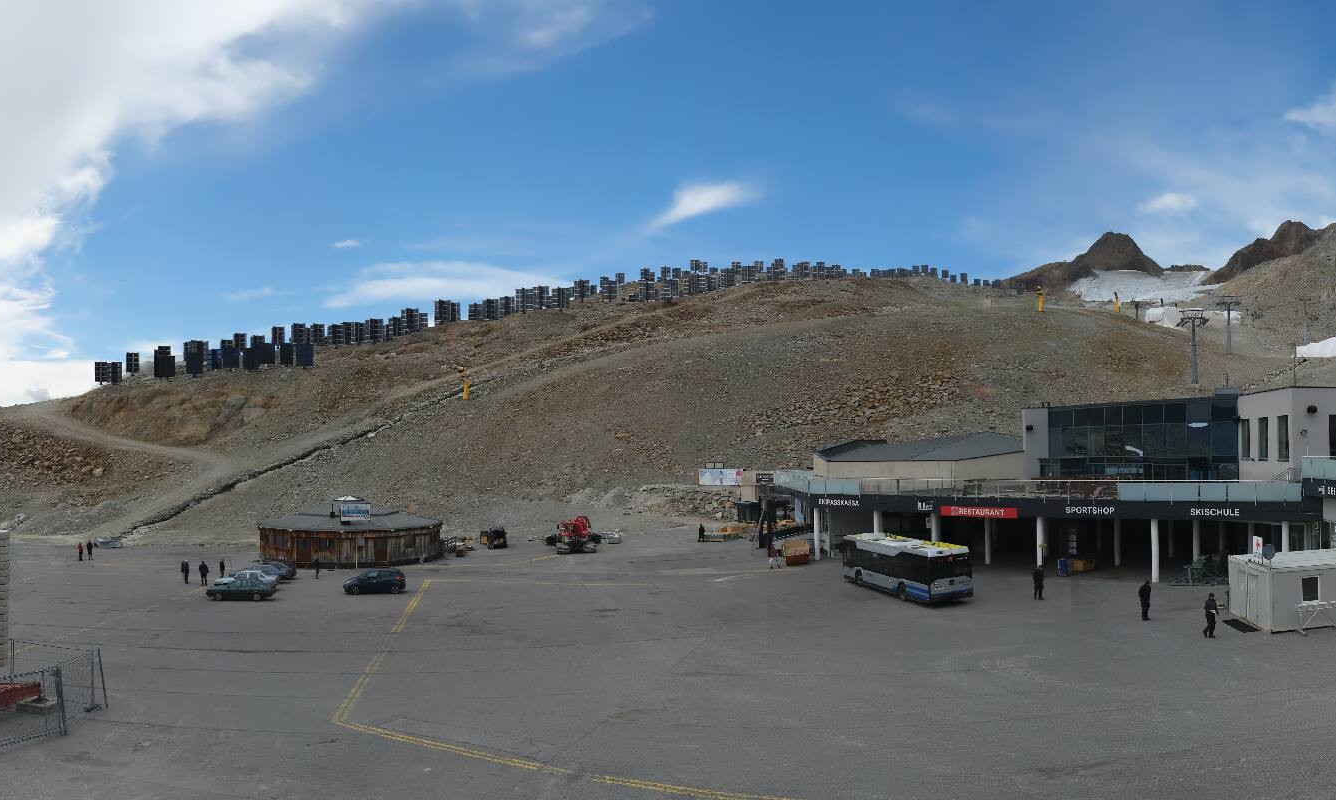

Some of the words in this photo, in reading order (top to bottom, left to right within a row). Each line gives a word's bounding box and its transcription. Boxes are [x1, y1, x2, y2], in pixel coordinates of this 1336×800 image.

[959, 507, 1005, 516] RESTAURANT
[1065, 506, 1115, 515] SPORTSHOP
[1190, 508, 1240, 517] SKISCHULE
